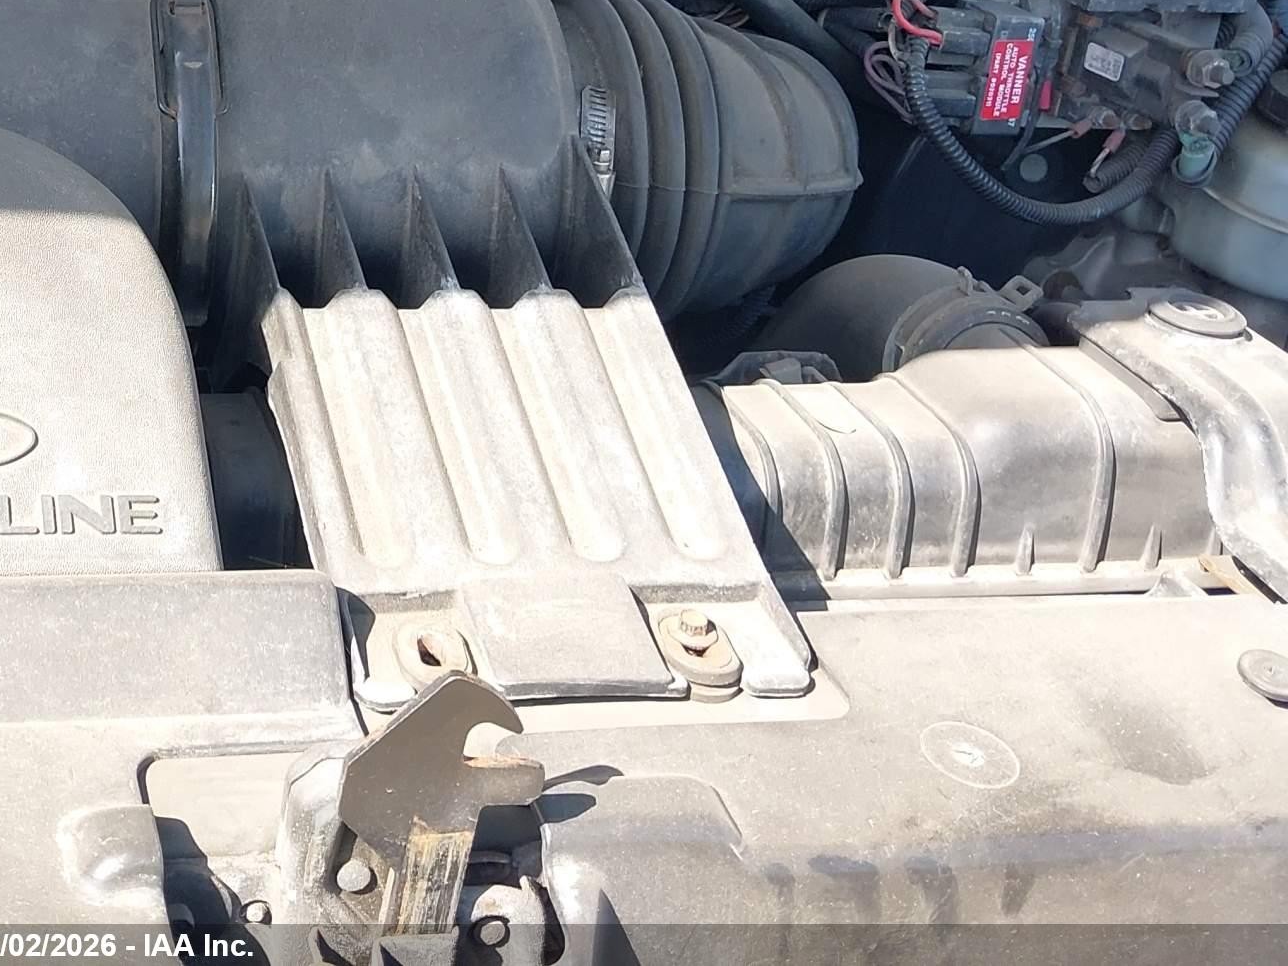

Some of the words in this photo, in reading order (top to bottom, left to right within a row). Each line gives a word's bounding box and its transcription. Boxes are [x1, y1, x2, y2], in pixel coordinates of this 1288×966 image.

[1000, 42, 1014, 81] CONTROL
[1010, 46, 1019, 69] AUTO
[1000, 72, 1015, 113] THROTTLE
[1010, 55, 1029, 104] VANNER
[993, 84, 1006, 117] MODULE
